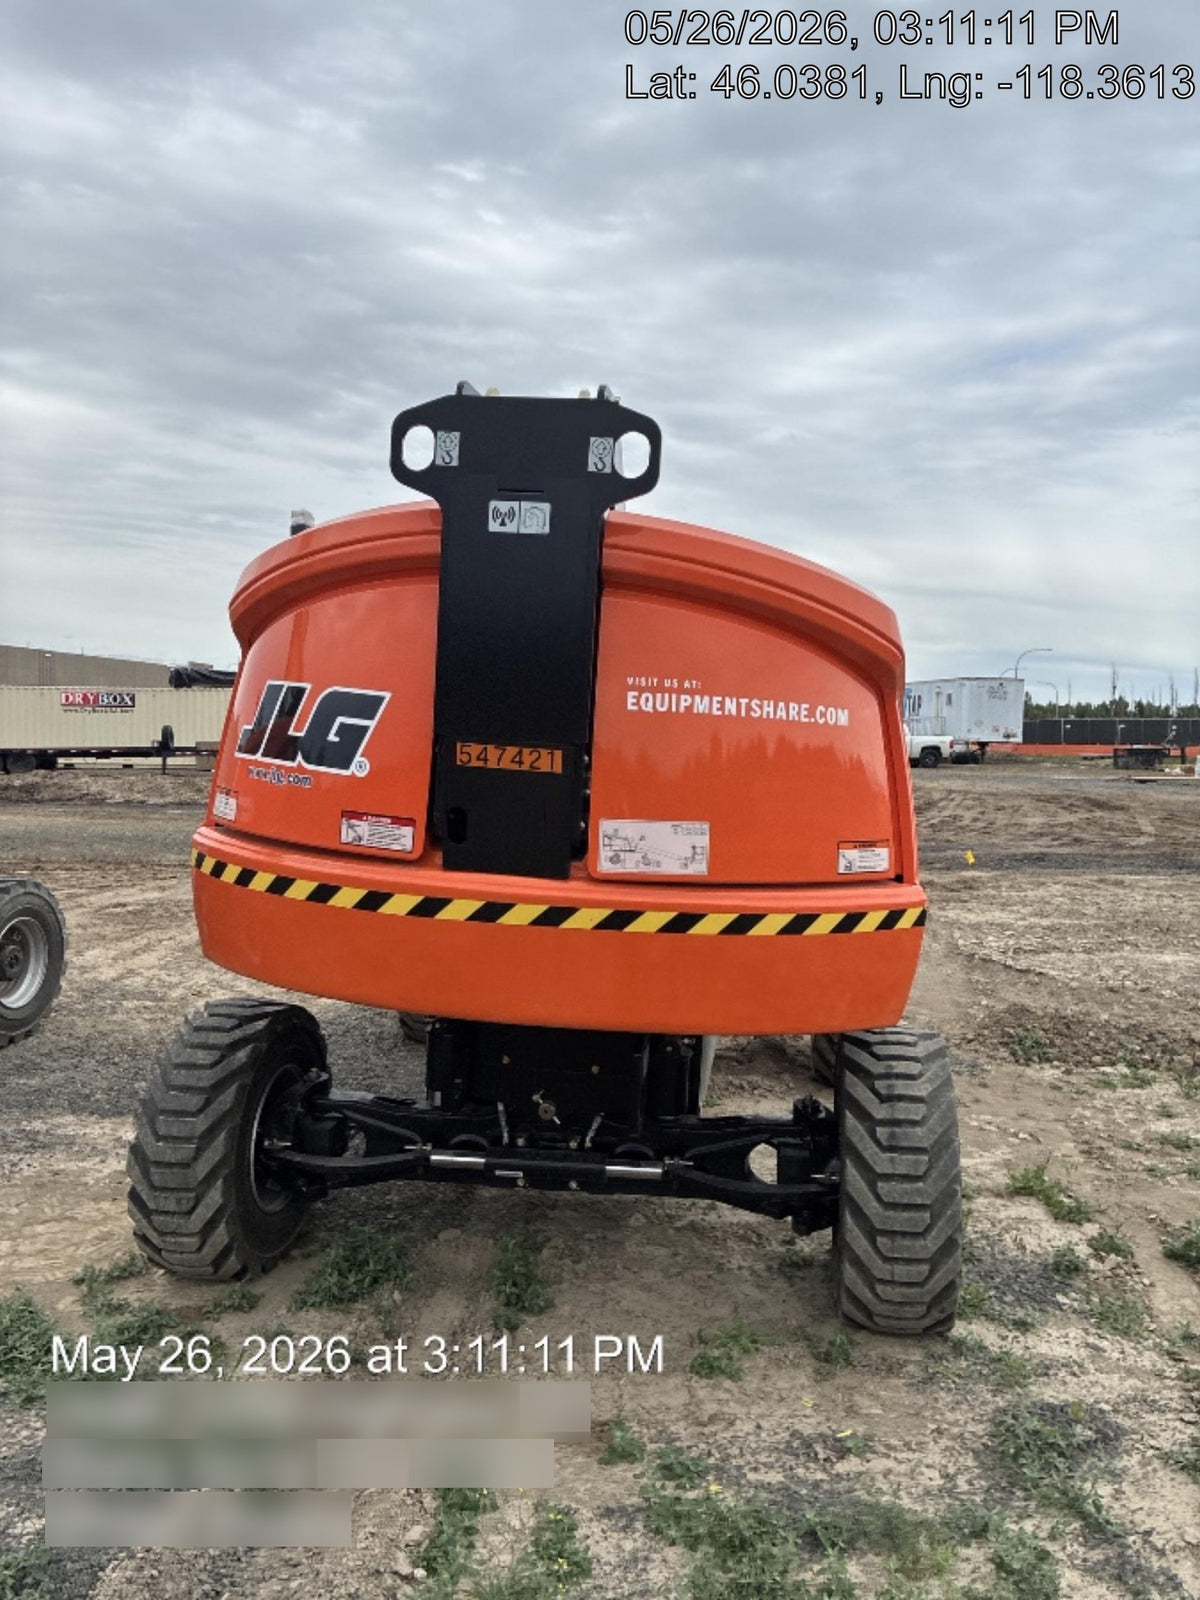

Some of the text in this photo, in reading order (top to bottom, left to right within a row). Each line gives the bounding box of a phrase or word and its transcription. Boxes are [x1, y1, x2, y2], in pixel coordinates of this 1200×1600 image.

[626, 676, 701, 689] VISIT US AT:
[61, 692, 133, 705] DRY BOX
[626, 690, 849, 727] EQUIPMENTSHARE.COM
[234, 680, 392, 775] JLG
[458, 744, 555, 771] 547421
